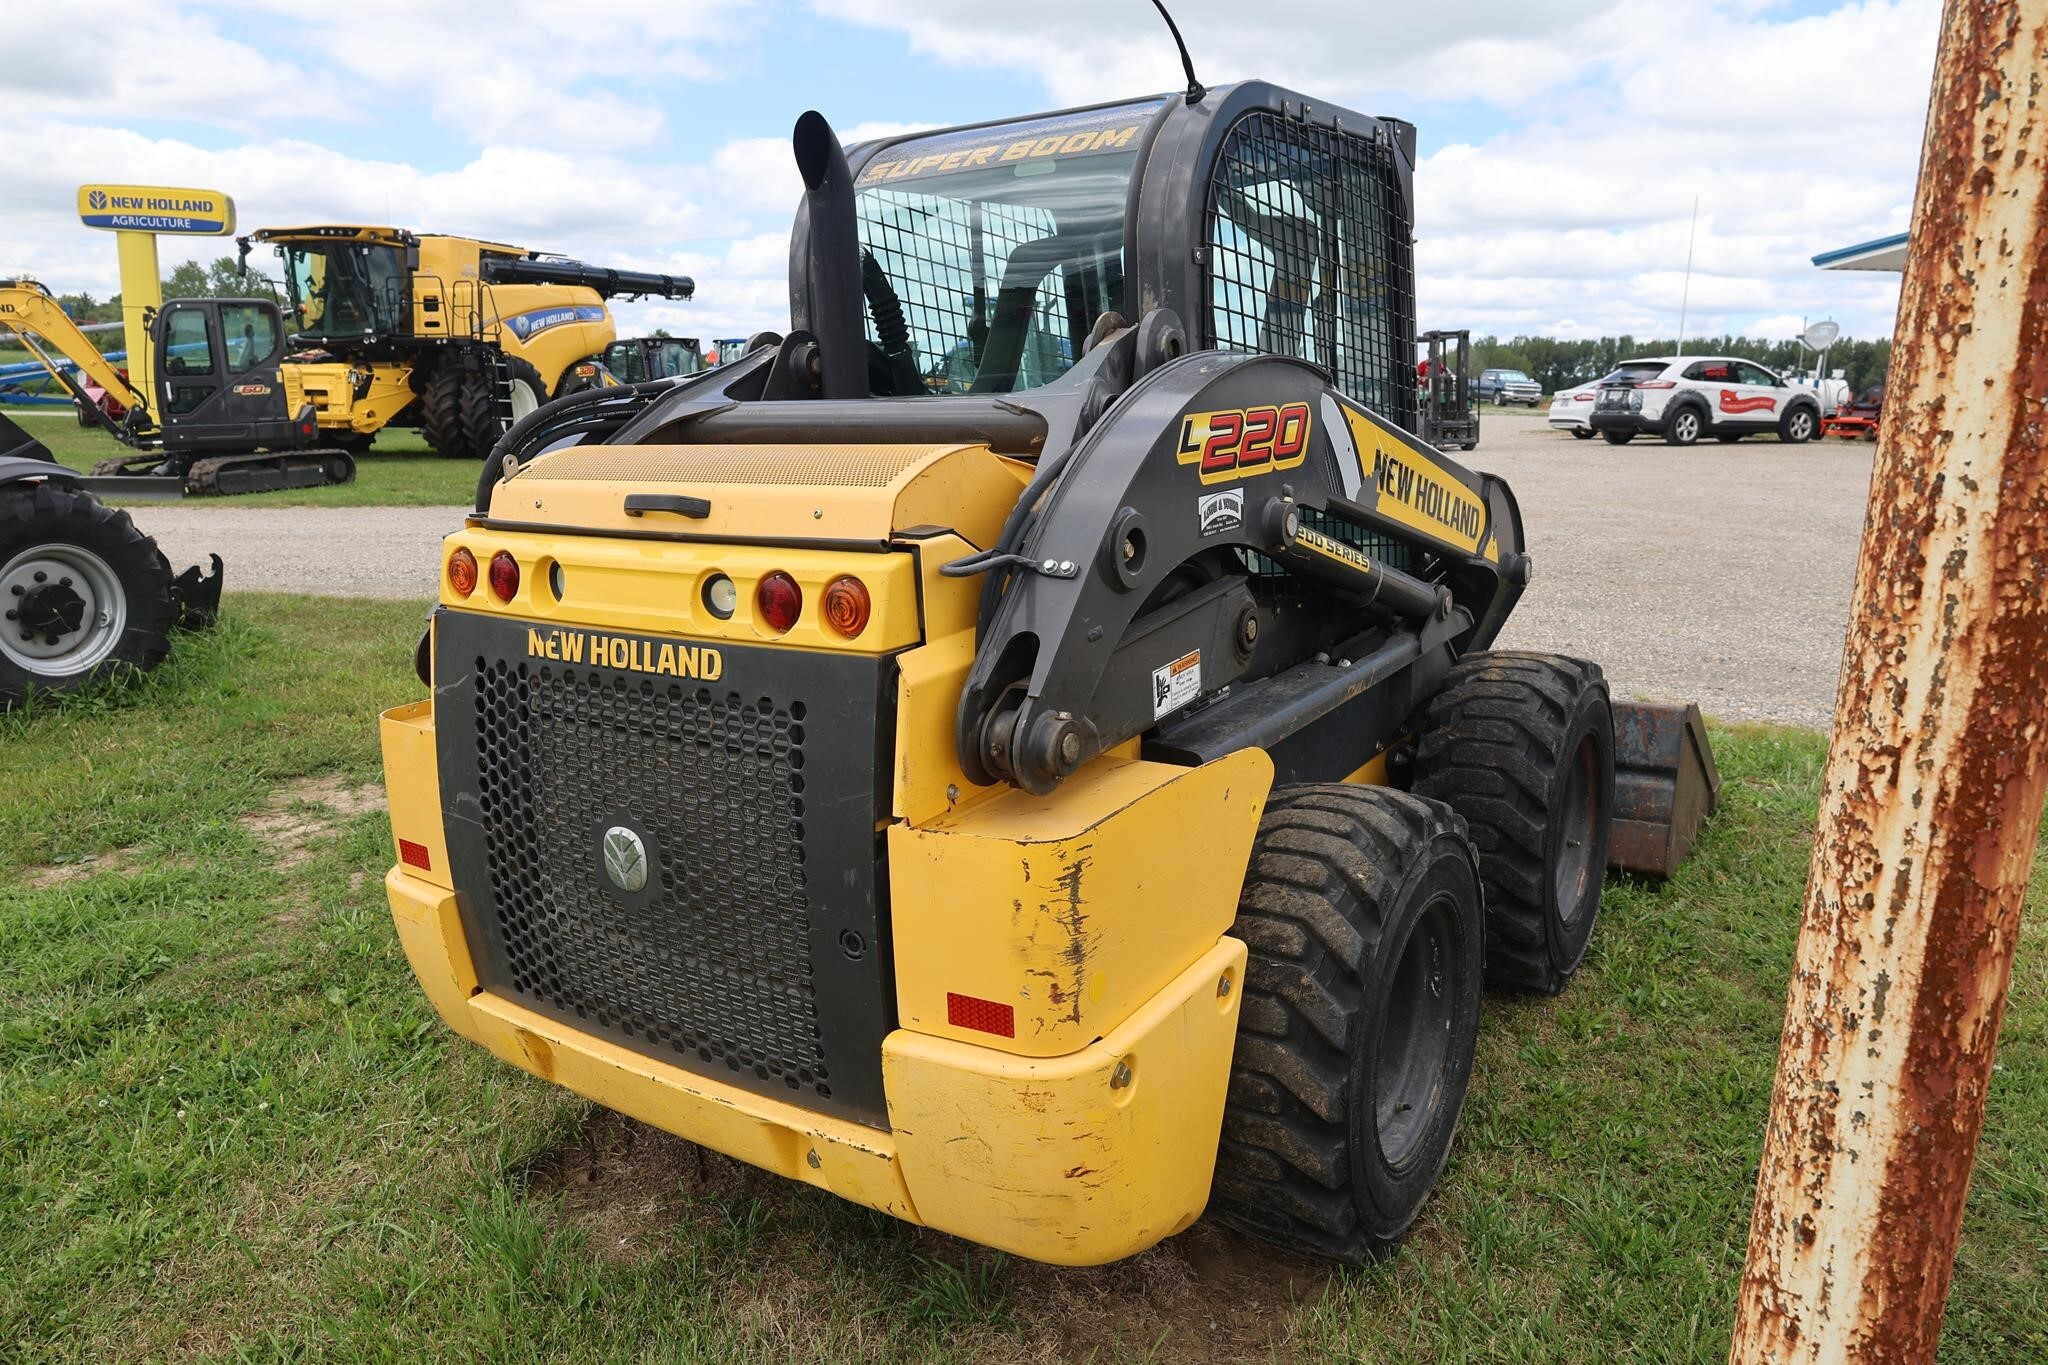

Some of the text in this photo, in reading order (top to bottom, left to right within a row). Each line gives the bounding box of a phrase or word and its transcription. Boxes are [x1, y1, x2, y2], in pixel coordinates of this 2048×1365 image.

[862, 126, 1140, 184] SUPER BOOM
[110, 196, 213, 213] NEW HOLLAND
[111, 215, 191, 229] AGRICULTURE
[530, 319, 546, 332] NEW
[545, 312, 575, 326] HOLLAND
[1178, 403, 1309, 477] L220
[1374, 448, 1480, 540] NEW HOLLAND
[1296, 525, 1369, 568] 200 SERIES
[527, 627, 723, 682] NEW HOLLAND
[1177, 655, 1198, 671] WARNING
